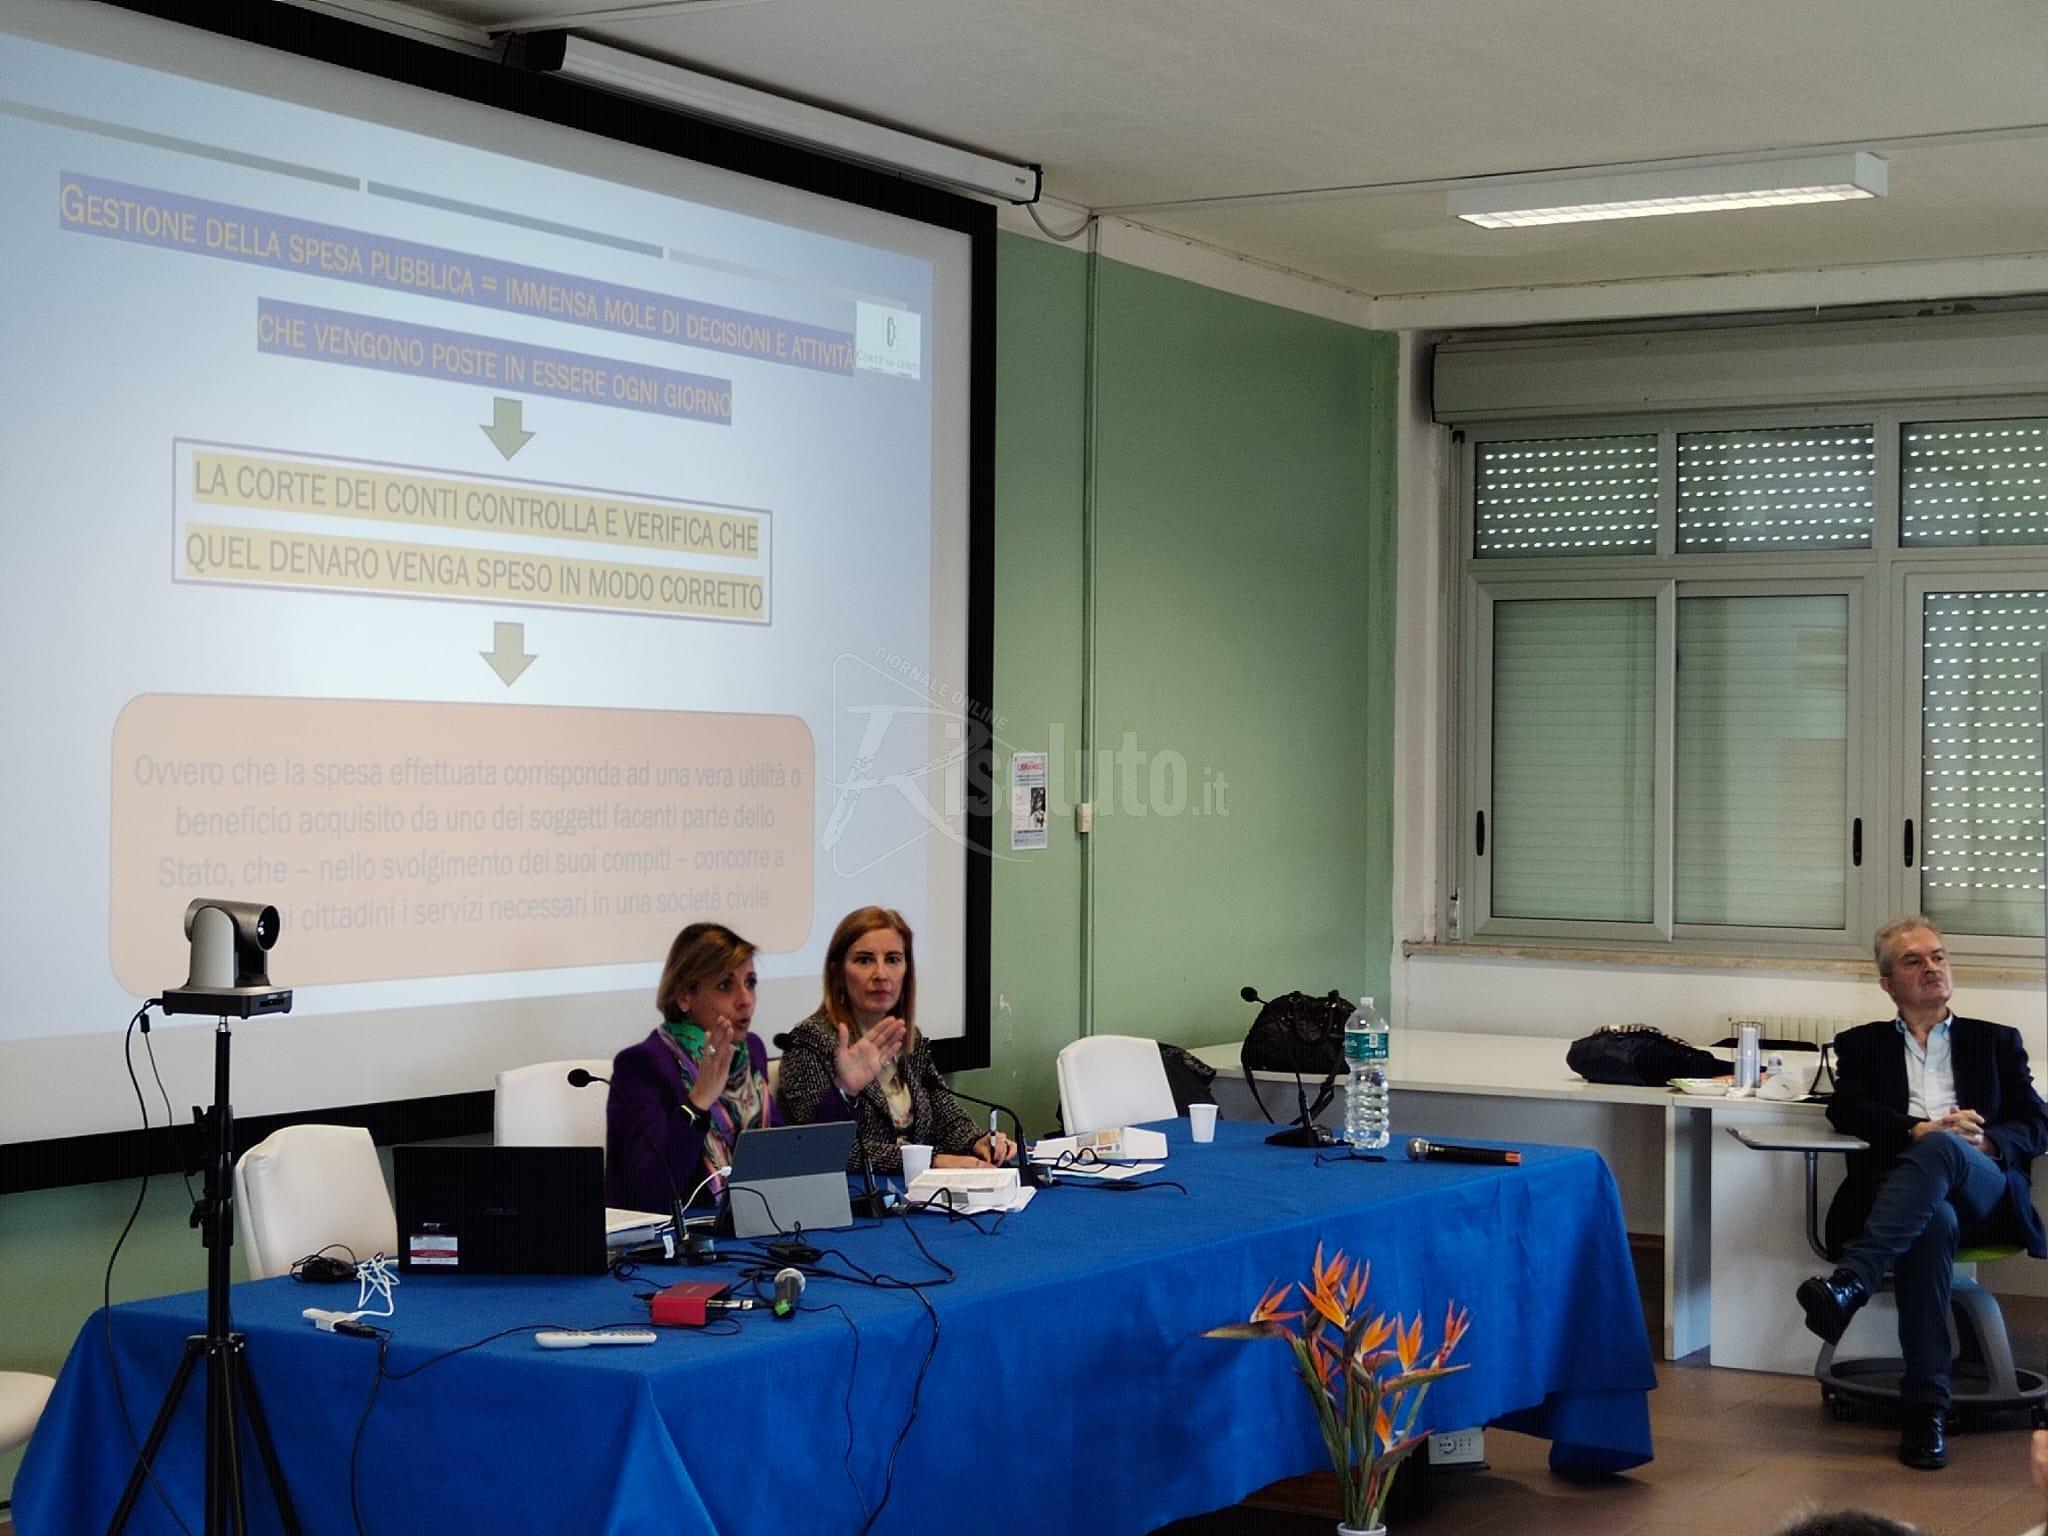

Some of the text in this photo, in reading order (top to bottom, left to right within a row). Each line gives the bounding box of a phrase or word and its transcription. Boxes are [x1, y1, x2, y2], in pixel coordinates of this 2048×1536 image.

[60, 183, 196, 243] GESTIONE
[205, 219, 281, 260] DELLA
[289, 235, 363, 275] SPESA
[370, 250, 475, 297] PUBBLICA
[506, 277, 598, 321] IMMENSA
[604, 298, 656, 332] MOLE
[662, 310, 680, 334] DI
[687, 315, 770, 354] DECISIONI
[776, 333, 786, 354] E
[258, 314, 732, 417] CHE VENGONO POSTE IN ESSERE OGNI GIORNO
[195, 460, 758, 552] LA CORTE DEI CONTI CONTROLLA E VERIFICA CHE
[186, 533, 763, 611] QUEL DENARO VENGA SPESO IN MODO CORRETTO
[134, 754, 800, 792] Ovvero che la spesa effettuata corrisponda ad una vera utilità o
[176, 803, 775, 840] beneficio acquisito da uno dei soggetti facenti parte dello
[159, 856, 234, 889] Stato,
[243, 855, 287, 884] che
[320, 853, 376, 882] nello
[383, 851, 512, 885] svolgimento
[519, 849, 549, 876] dei
[555, 848, 595, 874] suoi
[603, 847, 670, 877] compiti
[695, 850, 770, 871] concorre
[775, 851, 784, 869] a
[302, 899, 394, 931] cittadini
[414, 895, 481, 926] servizi
[490, 890, 587, 921] necessari
[593, 888, 609, 915] in
[616, 892, 650, 915] una
[657, 885, 720, 913] società
[727, 884, 769, 910] civile
